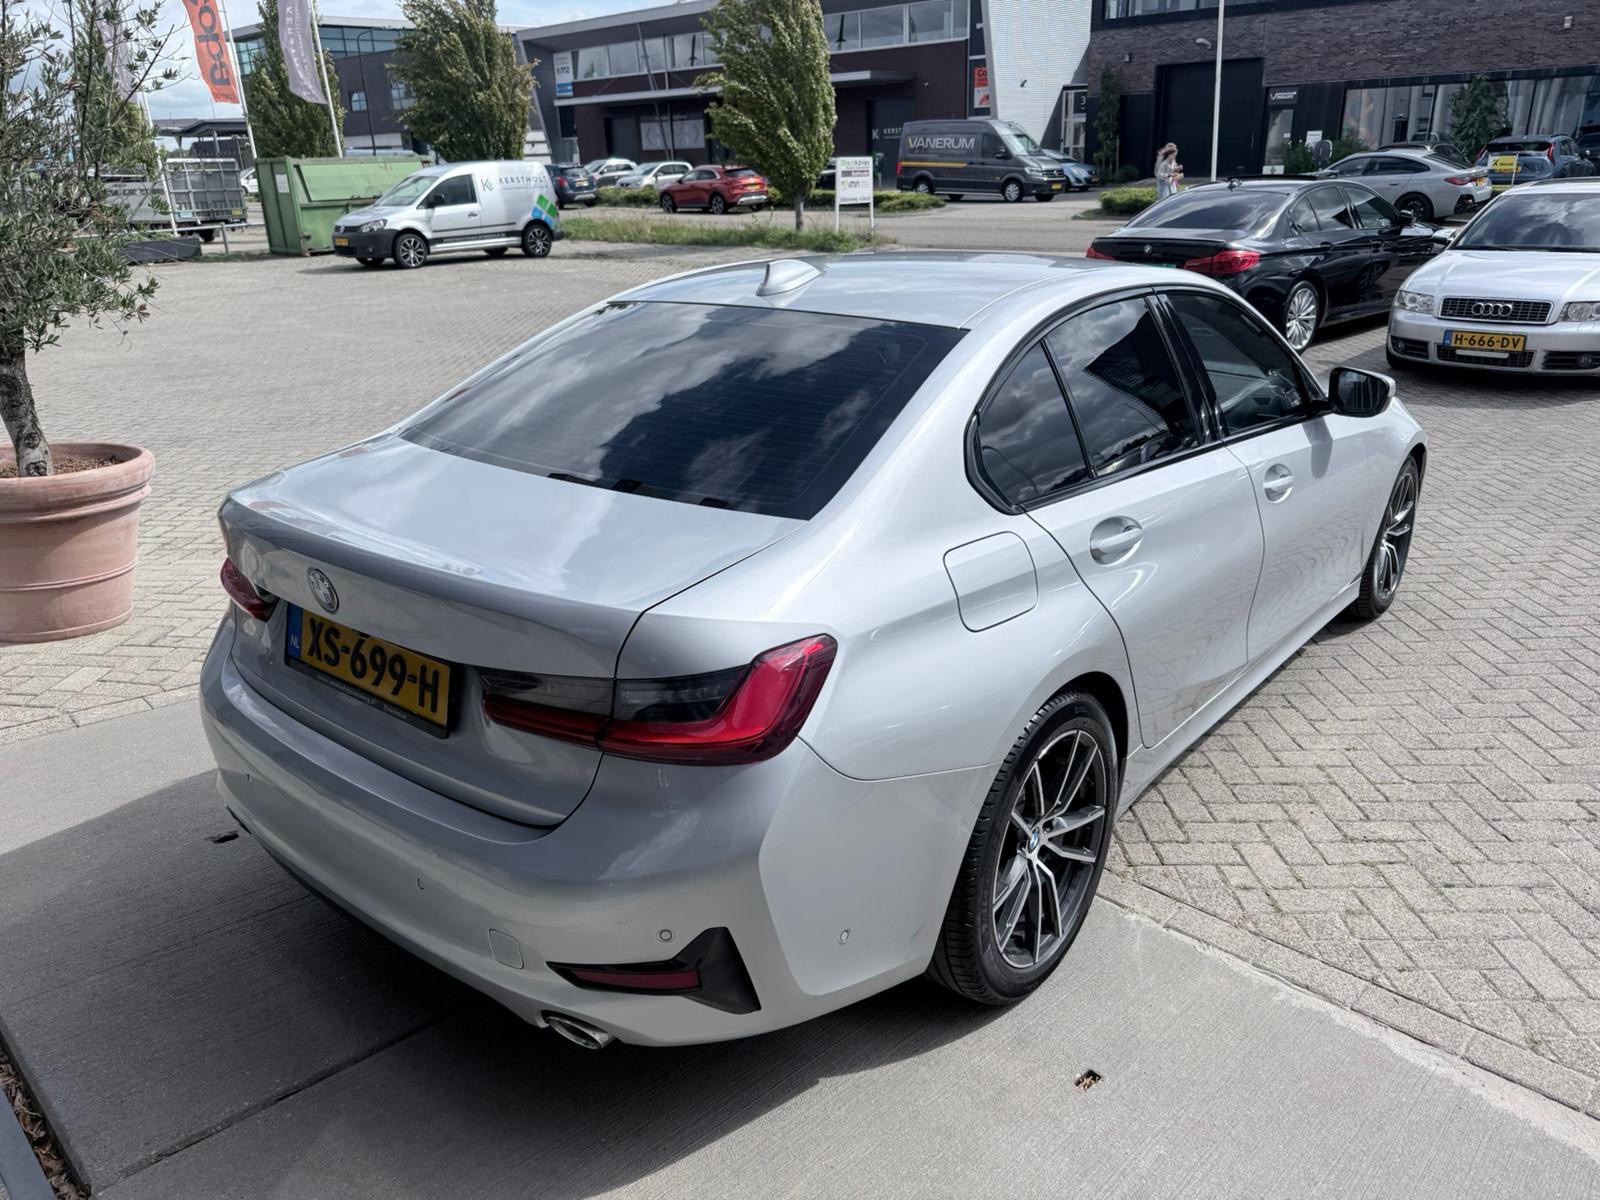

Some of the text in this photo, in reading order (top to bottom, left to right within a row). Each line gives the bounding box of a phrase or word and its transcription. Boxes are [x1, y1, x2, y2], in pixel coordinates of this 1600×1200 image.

[883, 127, 902, 135] KERST
[908, 137, 975, 150] VANERUM
[499, 176, 546, 185] KERSTHOLT
[1454, 333, 1521, 349] H-666-DV
[290, 634, 301, 649] NL
[307, 617, 441, 714] XS-699-H
